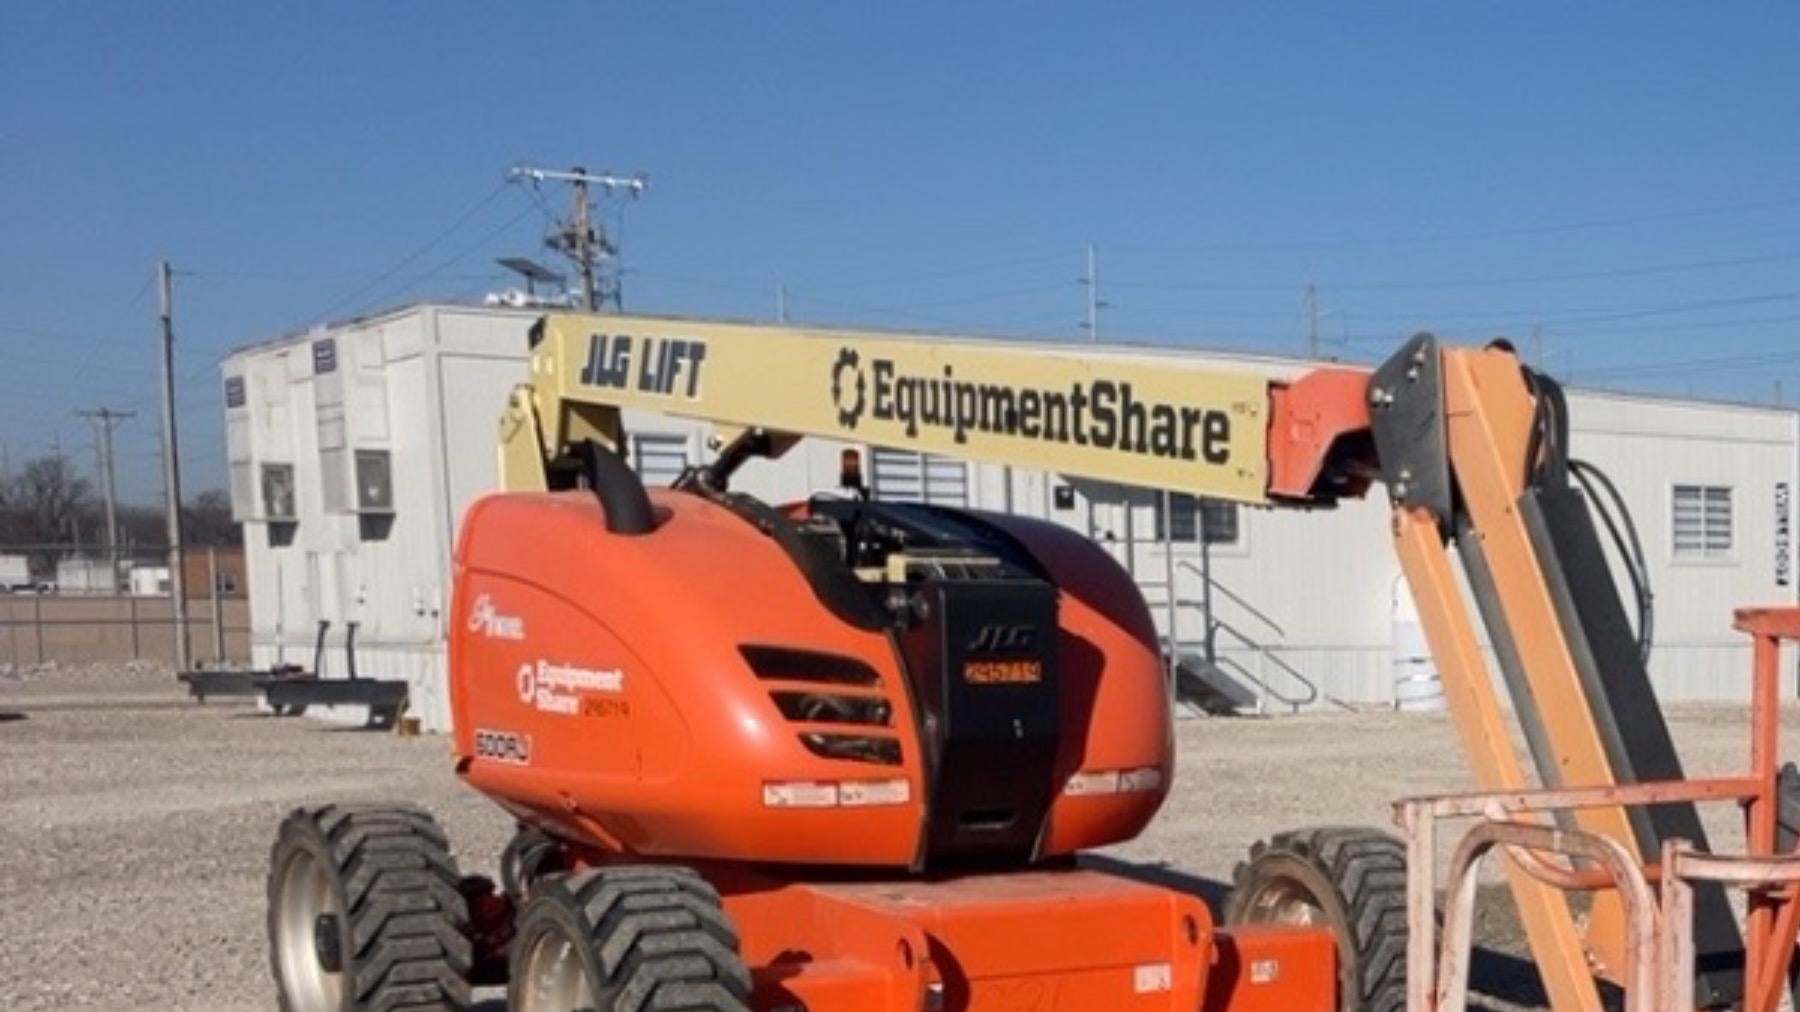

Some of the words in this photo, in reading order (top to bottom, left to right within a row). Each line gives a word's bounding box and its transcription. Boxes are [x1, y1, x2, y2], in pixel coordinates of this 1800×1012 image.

[580, 334, 632, 388] JLG
[638, 337, 706, 398] LIFT
[872, 358, 1232, 465] EquipmentShare
